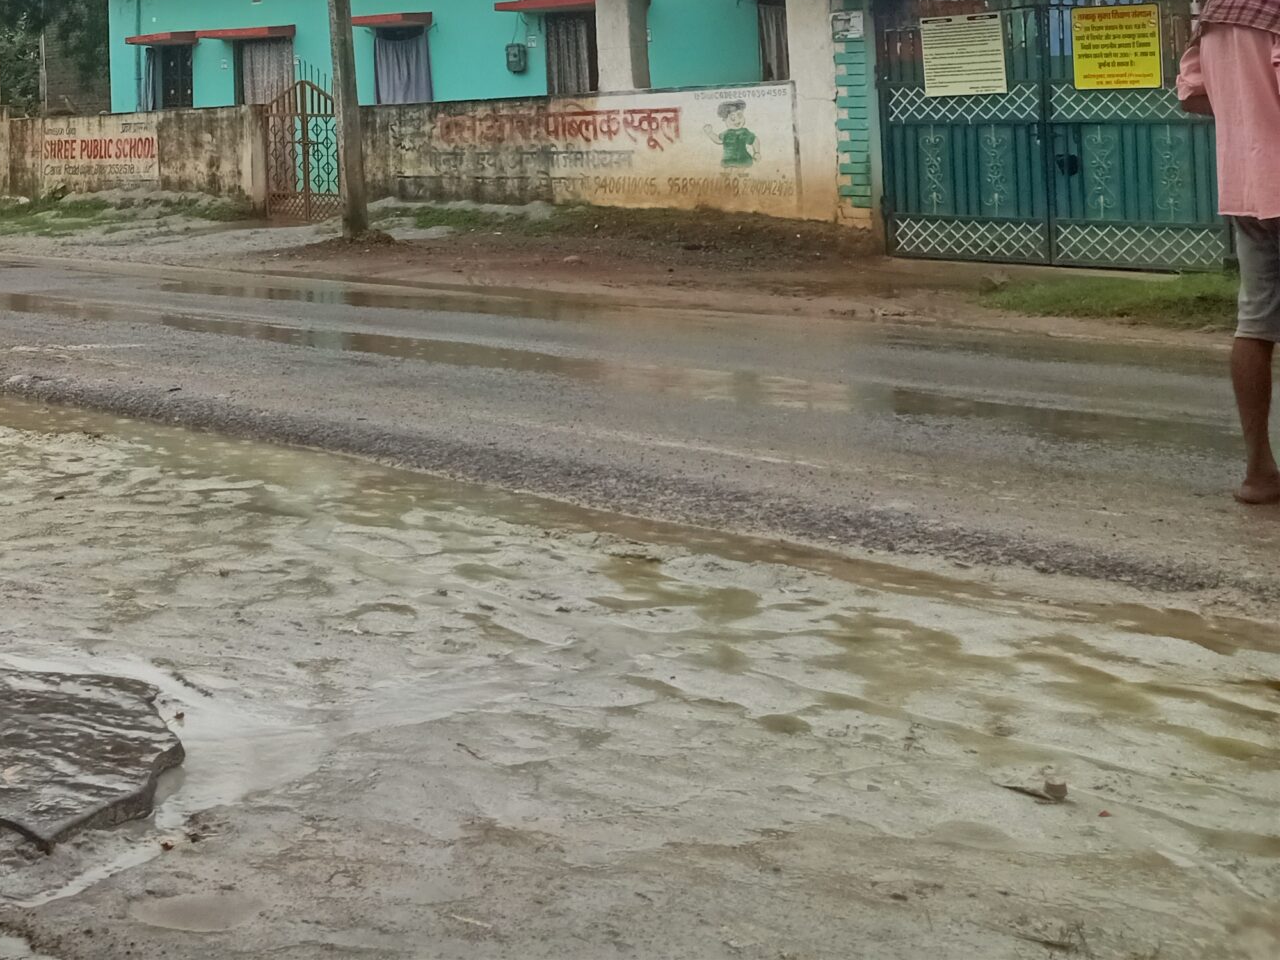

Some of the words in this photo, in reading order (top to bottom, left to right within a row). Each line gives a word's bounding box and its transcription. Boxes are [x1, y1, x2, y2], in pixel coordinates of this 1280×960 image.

[623, 107, 682, 152] स्कूल
[43, 139, 77, 160] SHREE
[80, 138, 113, 160] PUBLIC
[115, 137, 156, 159] SCHOOL
